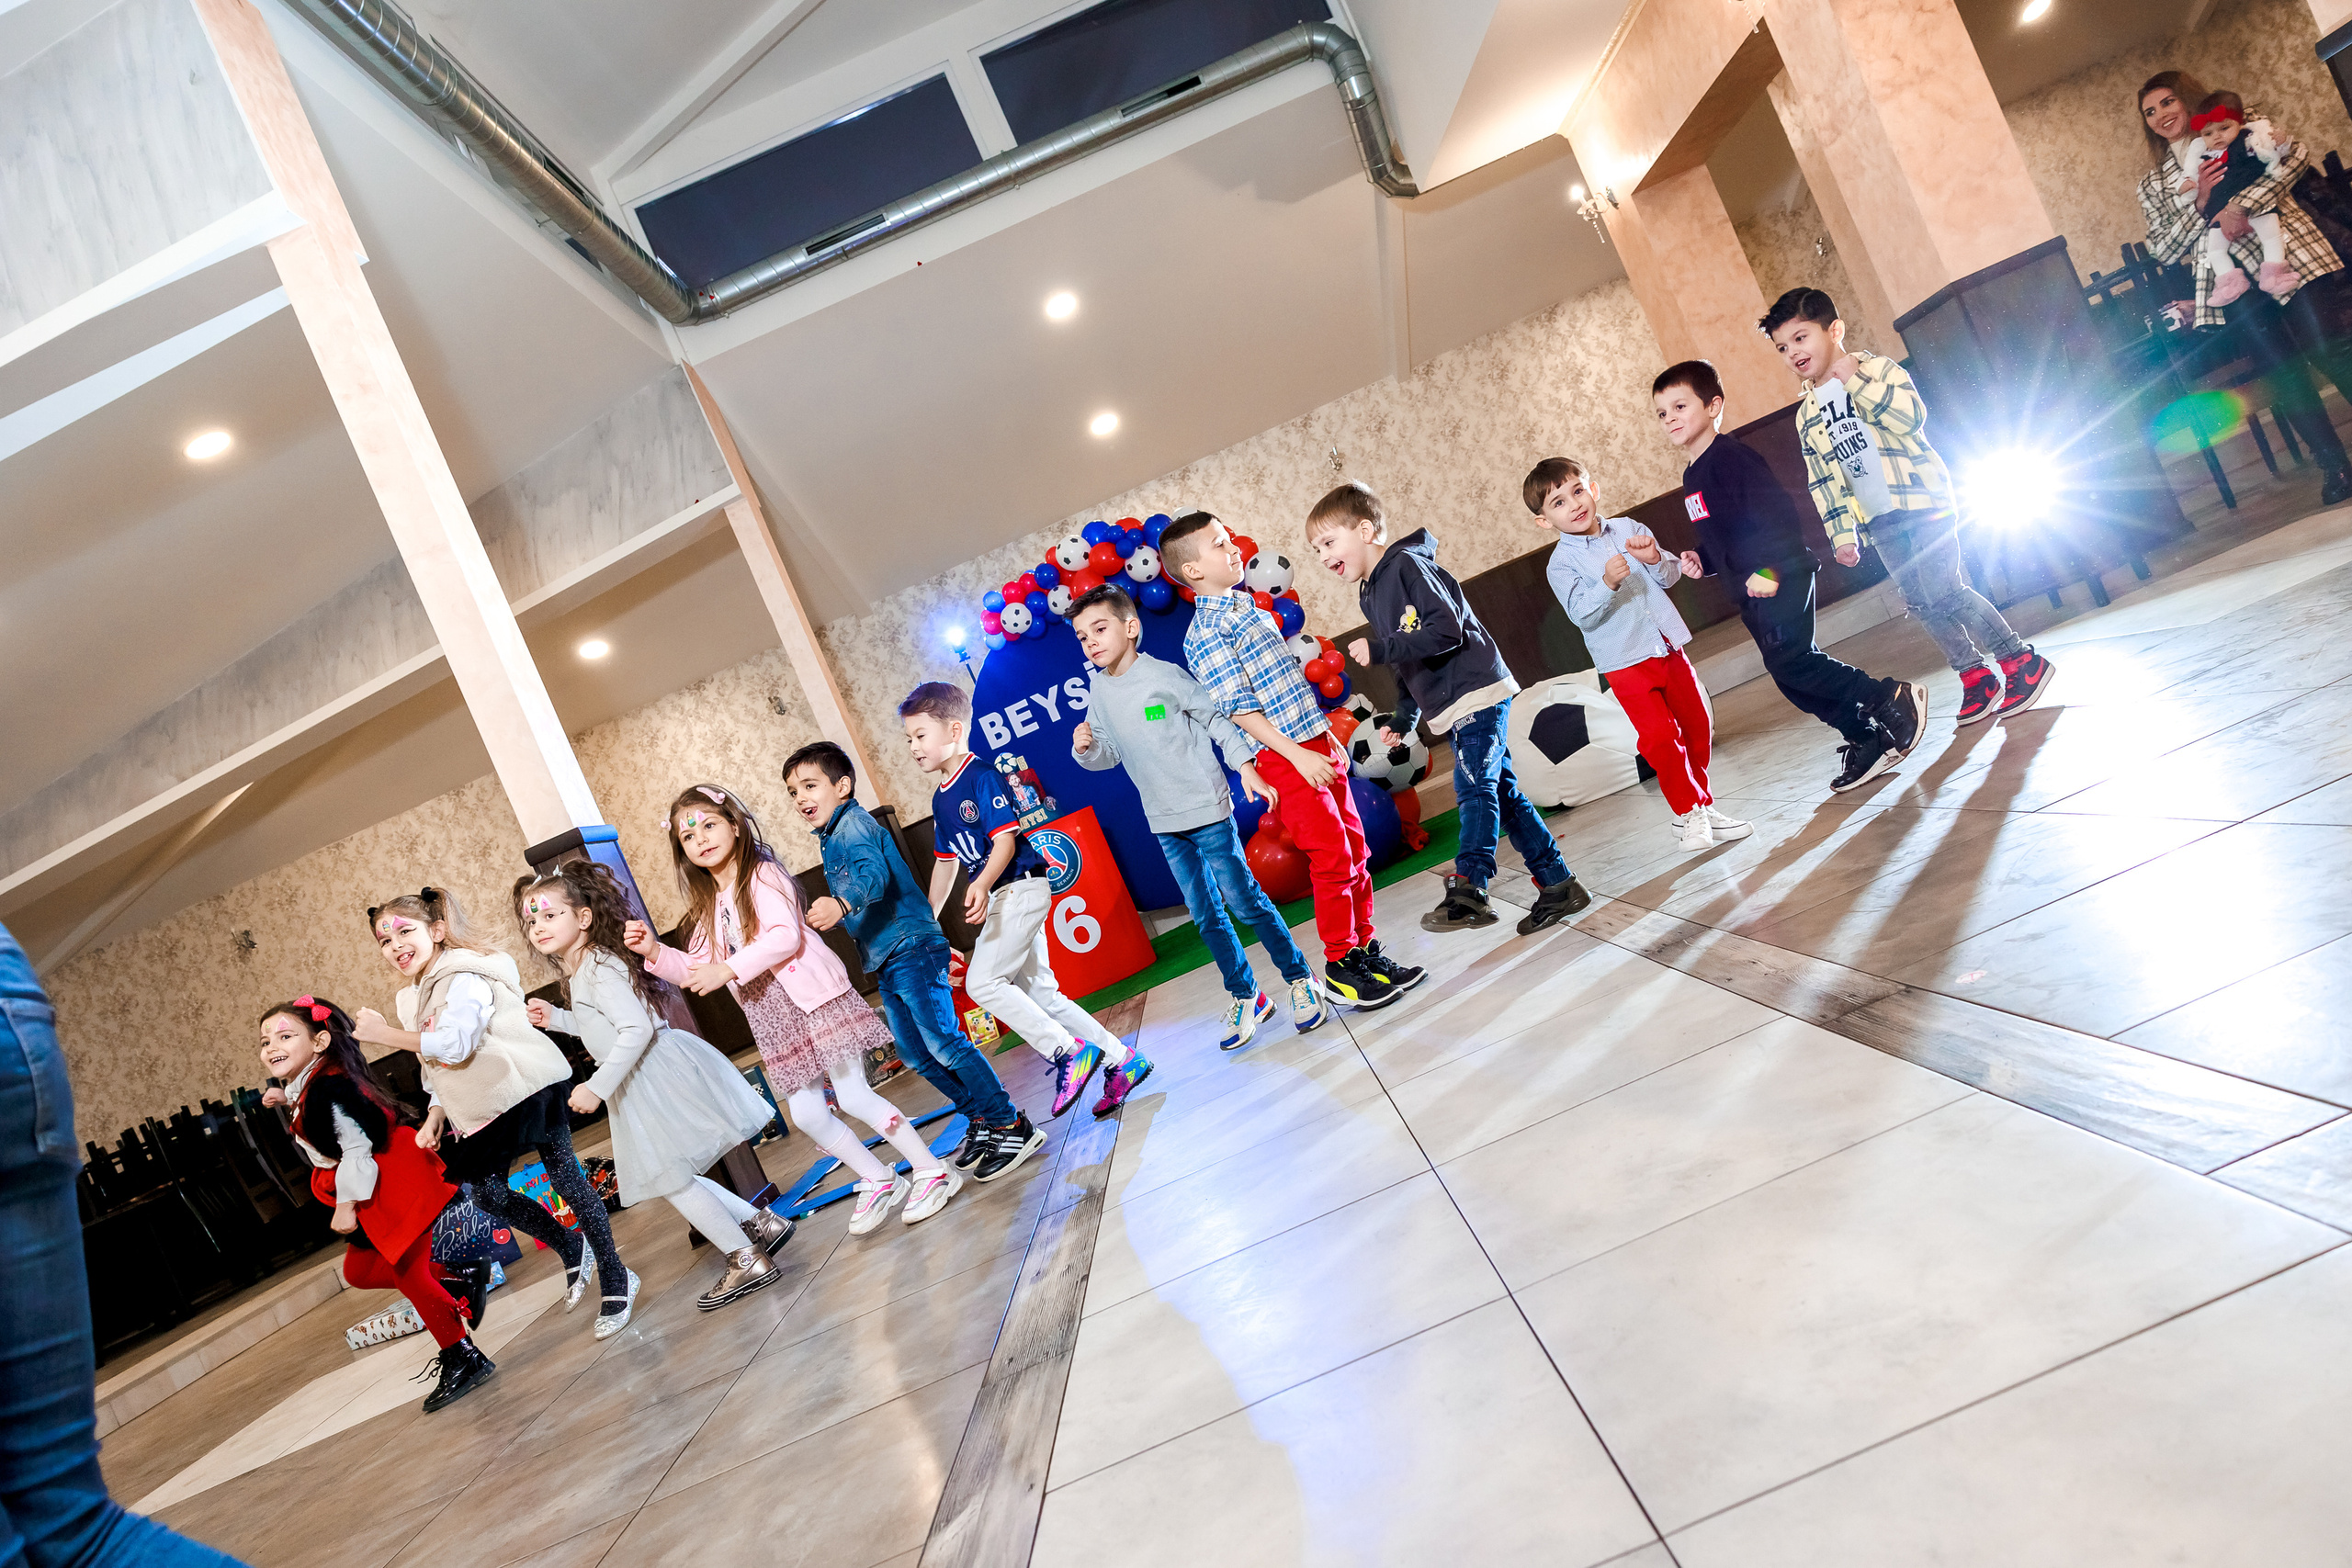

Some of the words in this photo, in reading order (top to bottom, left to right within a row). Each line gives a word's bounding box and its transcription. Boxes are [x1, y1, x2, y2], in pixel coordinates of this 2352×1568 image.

[1819, 392, 1856, 429] CLA
[1685, 493, 1709, 522] RVEL
[1019, 807, 1048, 831] EYSI
[1030, 834, 1061, 851] ARIS
[1056, 868, 1075, 888] GERMAIN
[1053, 895, 1102, 953] 6
[432, 1199, 475, 1235] Happy
[434, 1214, 492, 1261] Birthday
